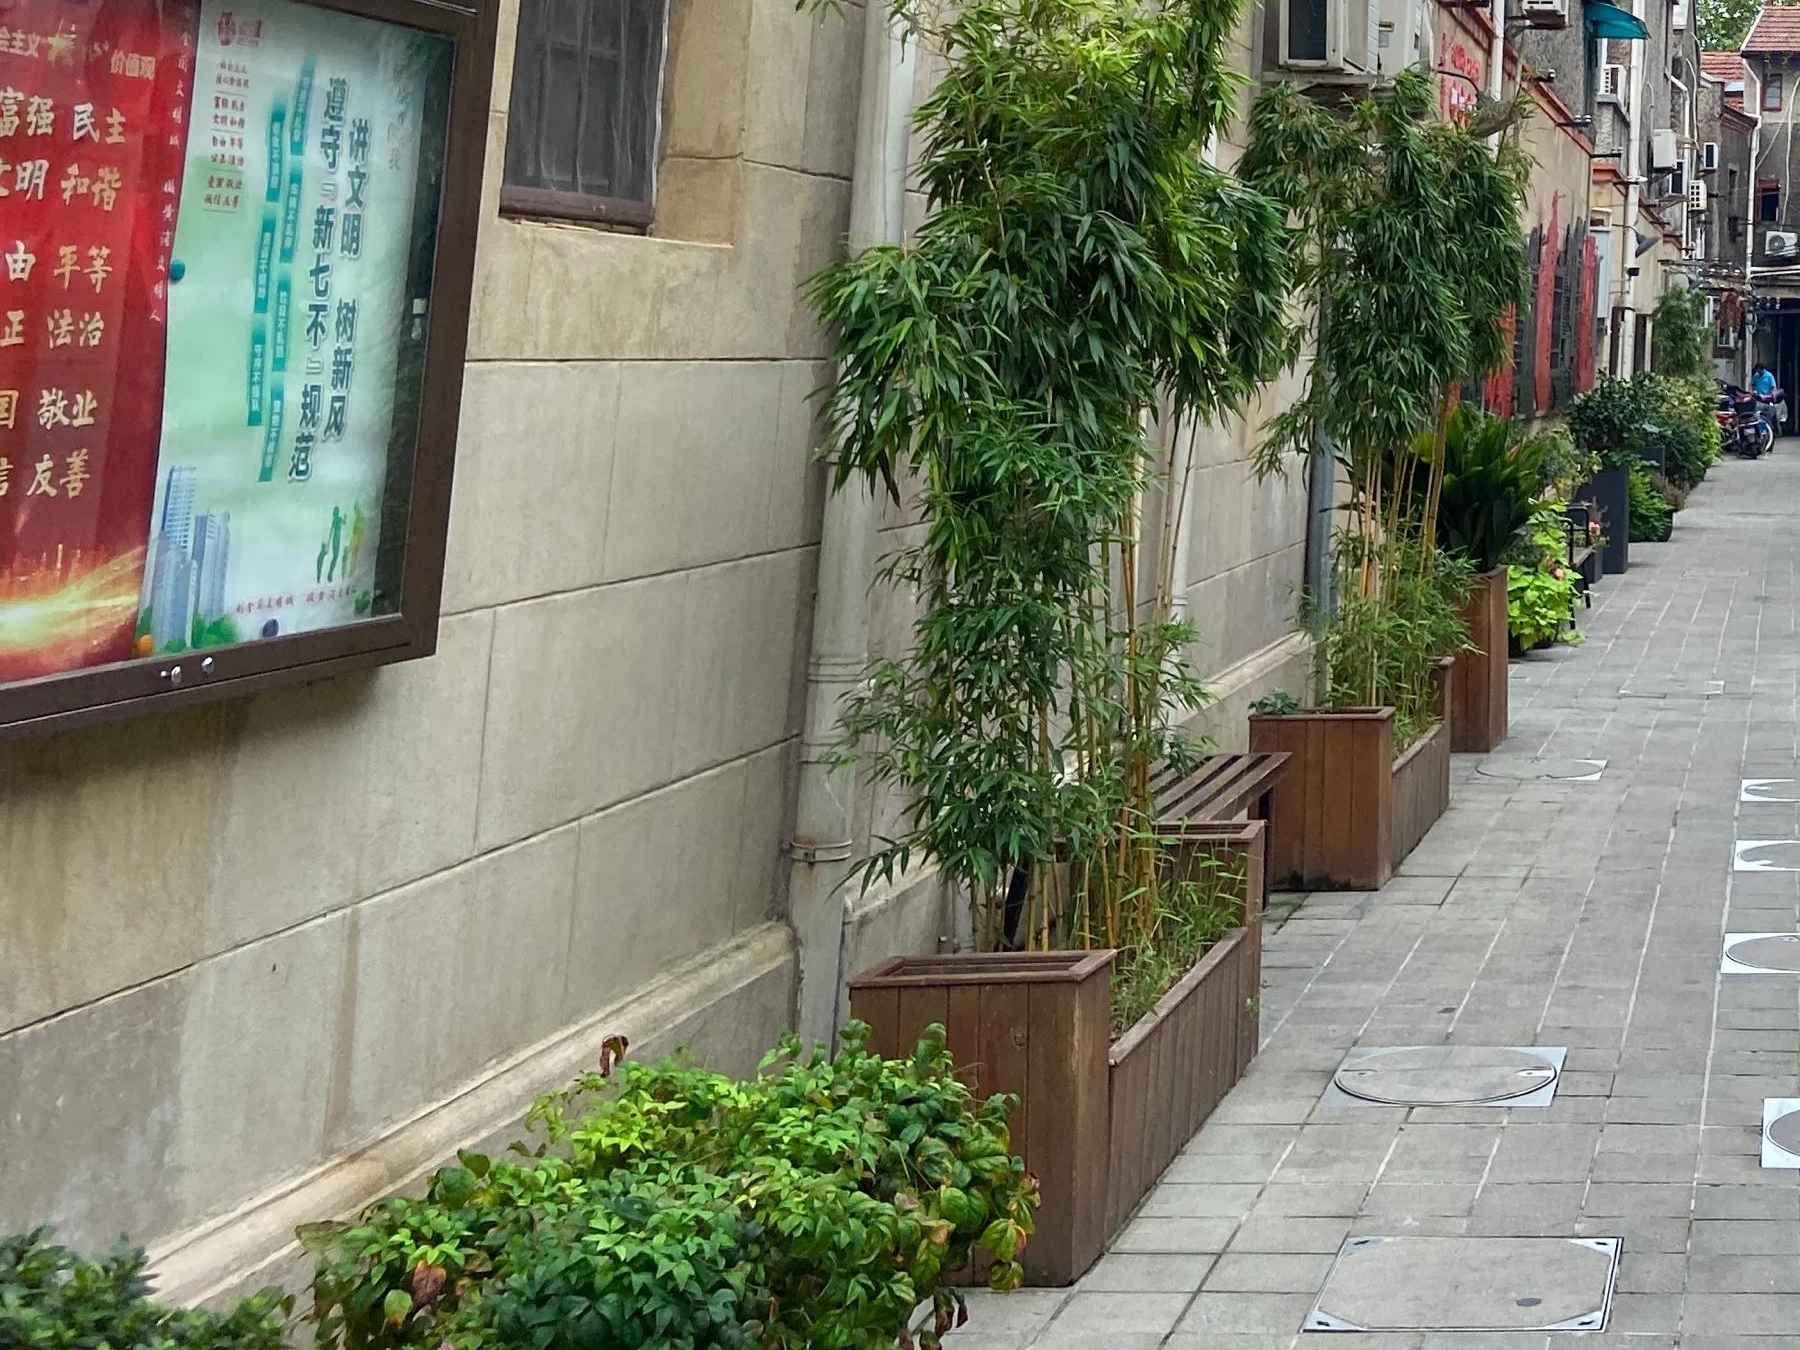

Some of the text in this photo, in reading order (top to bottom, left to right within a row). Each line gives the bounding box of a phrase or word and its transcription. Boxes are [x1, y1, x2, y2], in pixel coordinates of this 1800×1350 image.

[0, 86, 127, 144] 富强 民主
[61, 163, 122, 212] 和谐
[6, 240, 113, 294] 由 平等
[323, 119, 369, 440] 讲文明 树新风
[0, 309, 104, 348] 正 法治
[38, 388, 98, 430] 敬业
[27, 450, 91, 499] 友善
